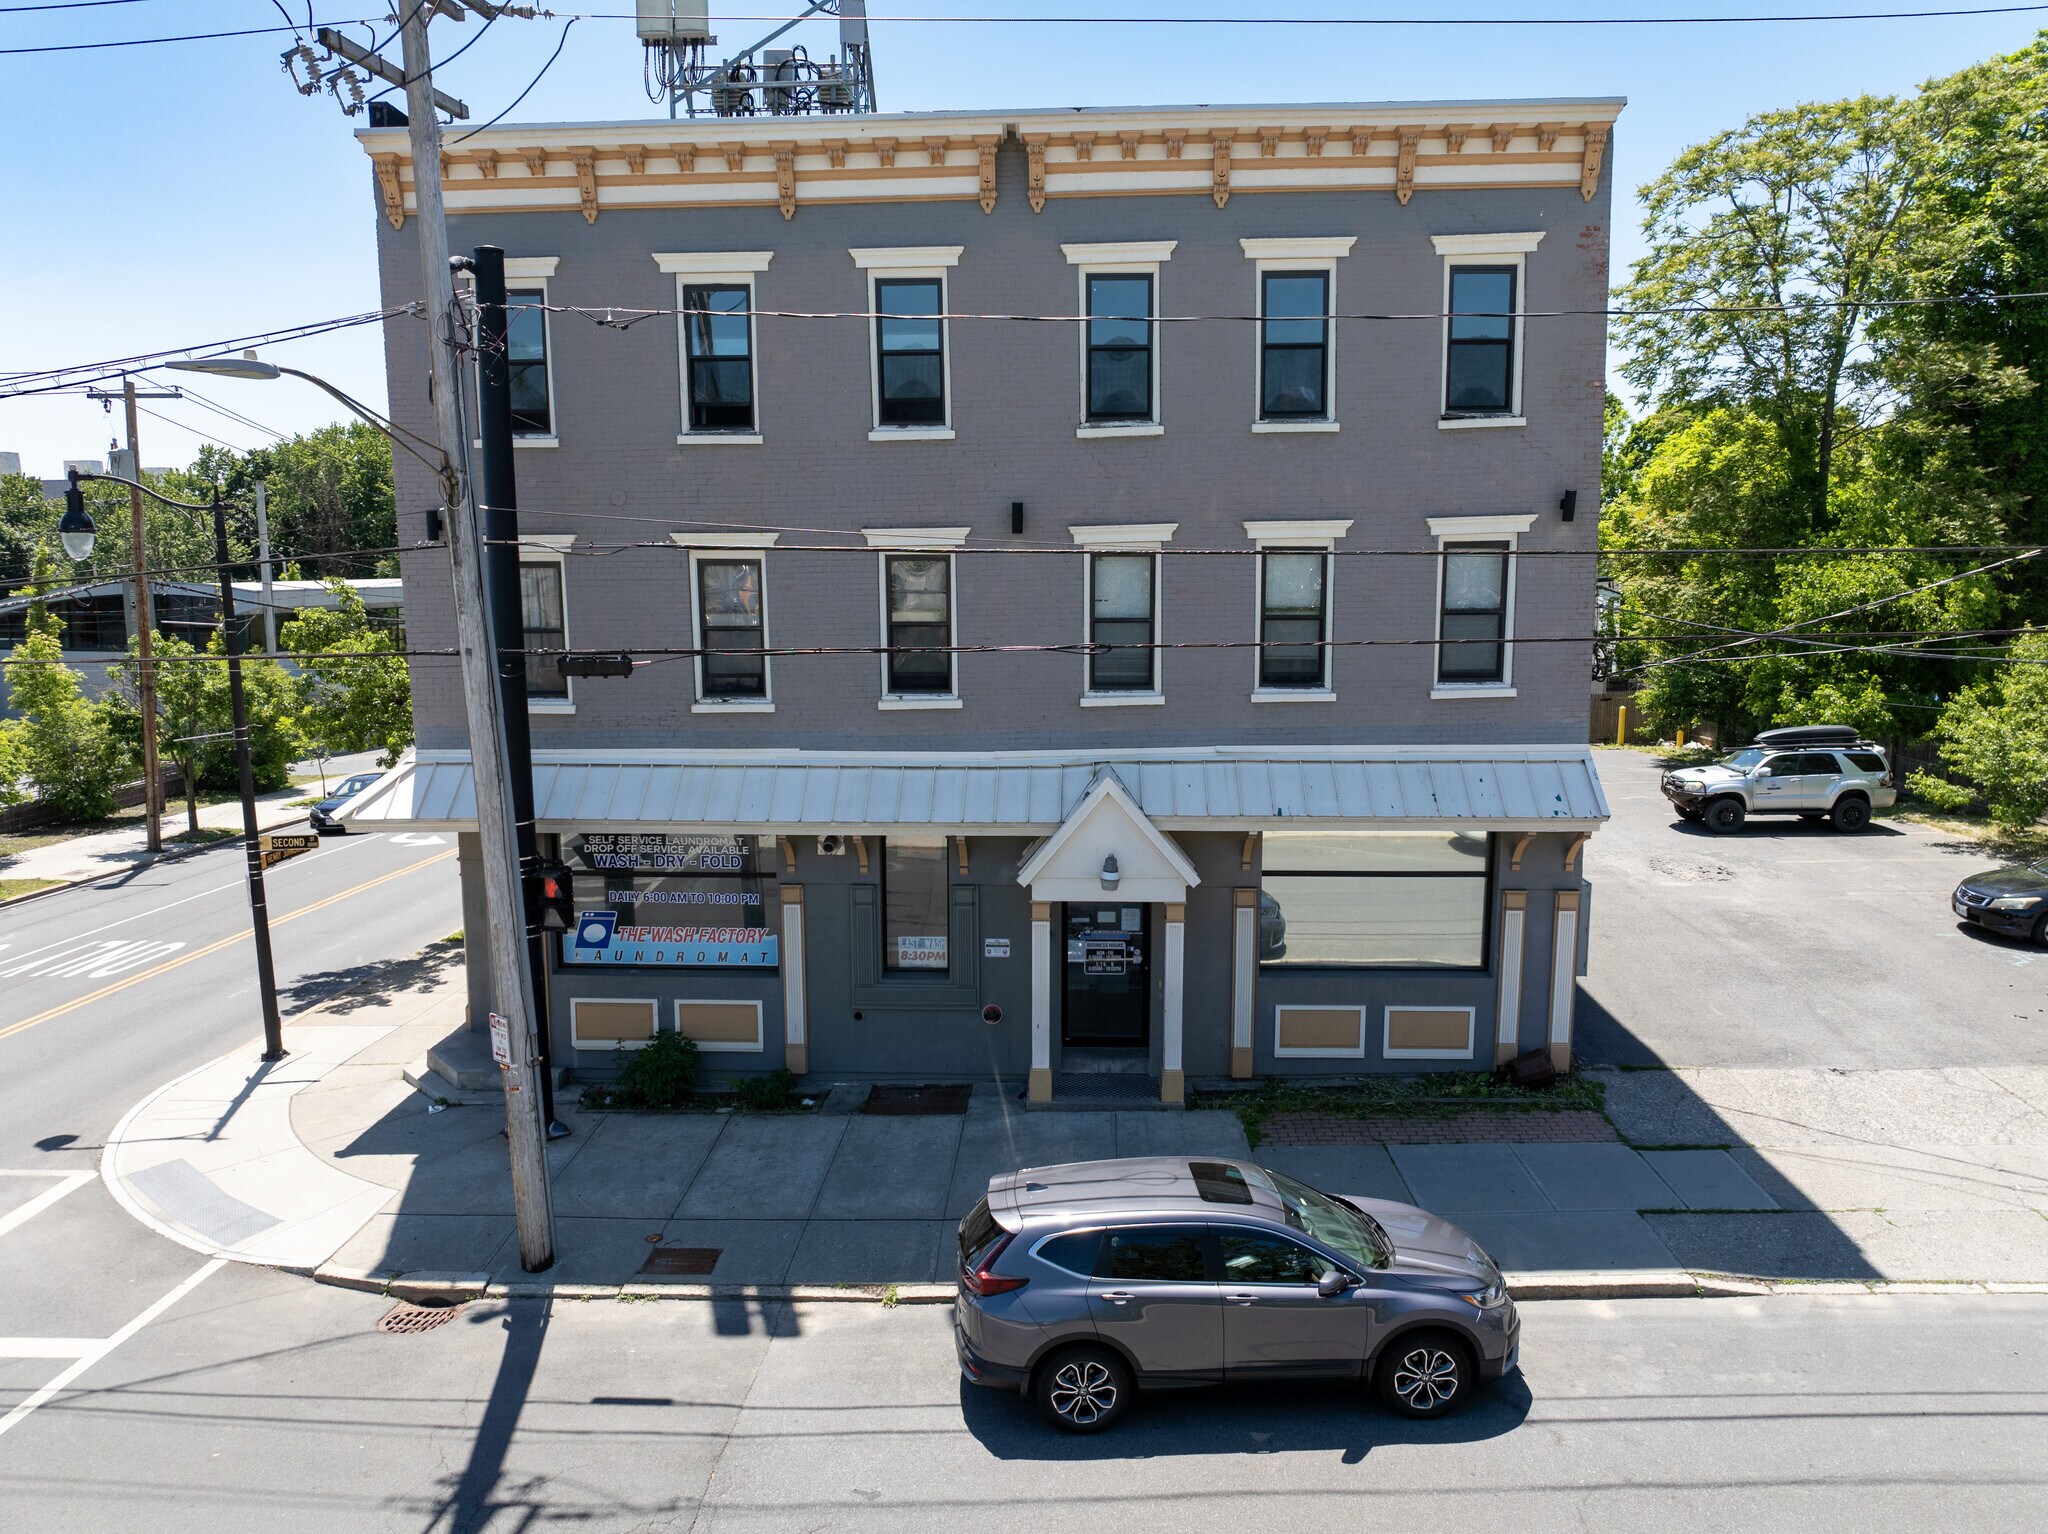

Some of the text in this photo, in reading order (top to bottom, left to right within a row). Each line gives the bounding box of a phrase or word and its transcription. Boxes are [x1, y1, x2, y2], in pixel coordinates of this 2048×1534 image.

[273, 838, 304, 847] SECOND
[588, 835, 744, 846] SELF SERVICE LAUNDROMAT
[583, 844, 749, 855] DROP OFF SERVICE AVAILABLE
[594, 853, 640, 868] WASH
[654, 854, 686, 869] DRY
[701, 854, 742, 869] FOLD
[608, 890, 760, 905] DAILY 6:00 AM TO 10:00 PM
[618, 925, 769, 944] THE WASH FACTORY
[901, 938, 945, 949] LAST WASH
[575, 950, 768, 963] LAUNDROMAT
[900, 950, 946, 961] 8:30PM
